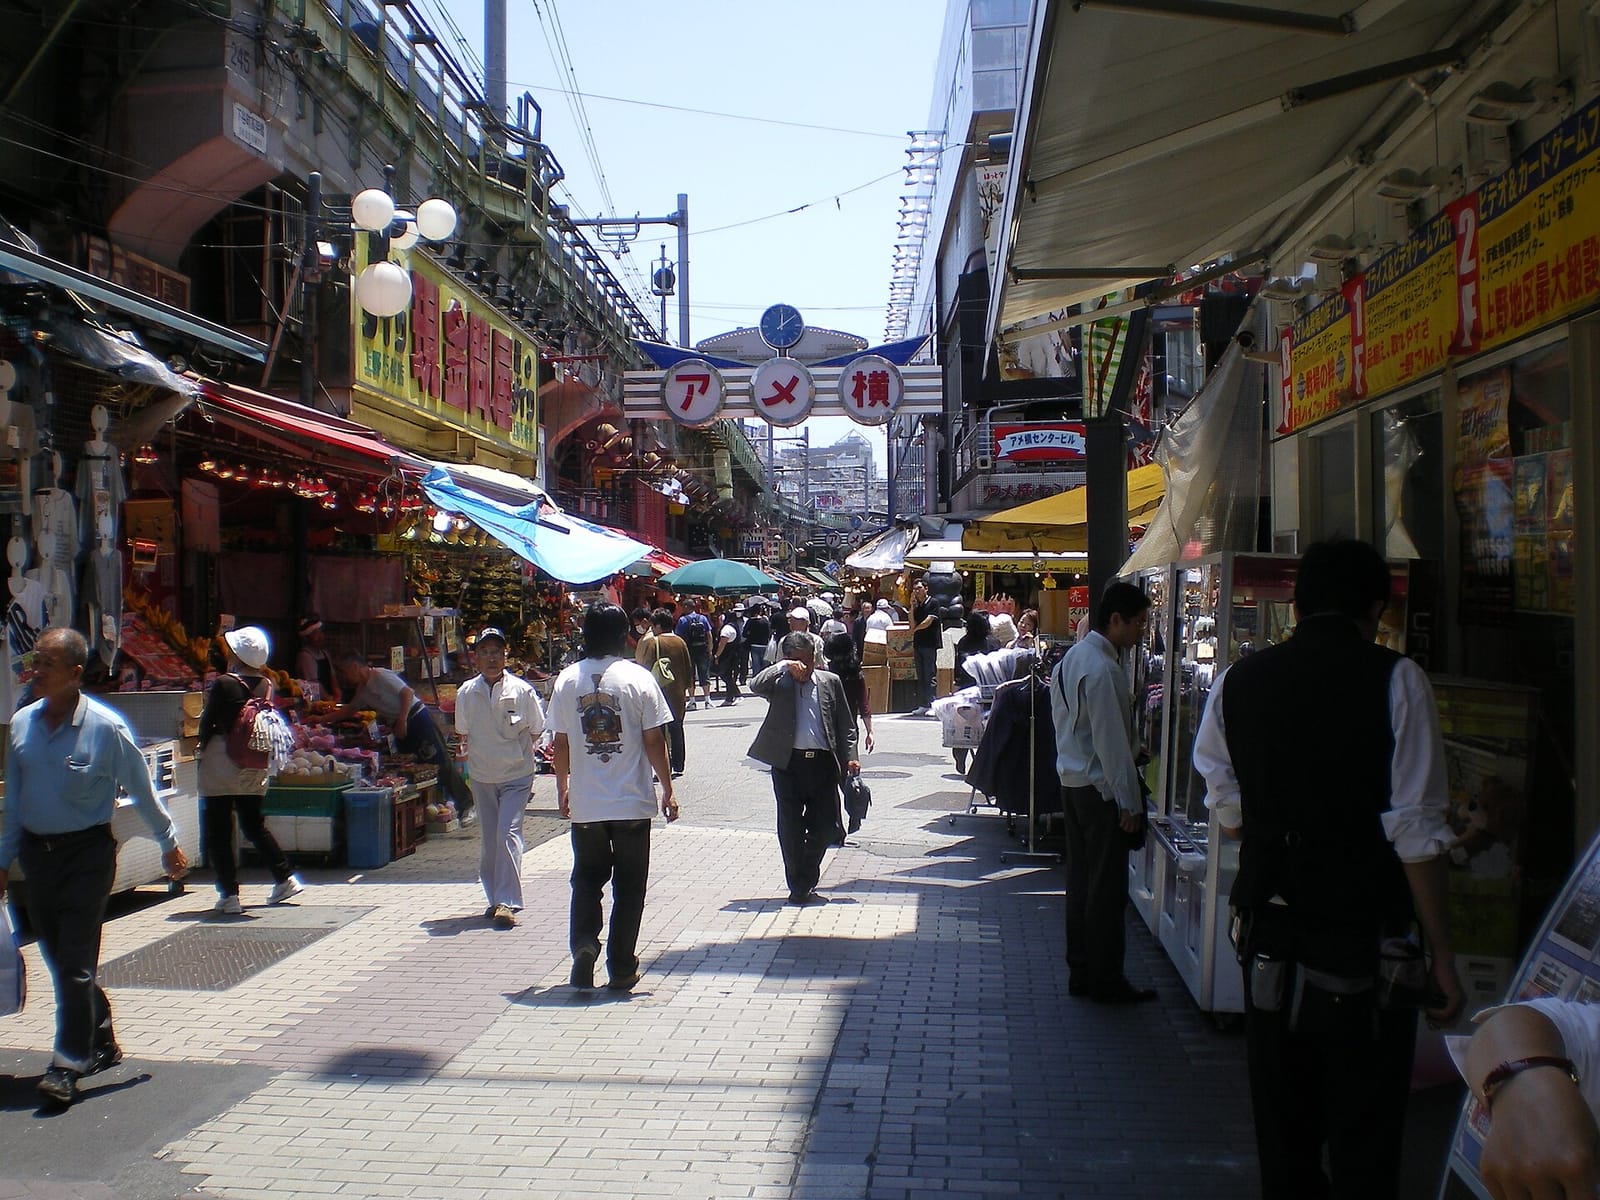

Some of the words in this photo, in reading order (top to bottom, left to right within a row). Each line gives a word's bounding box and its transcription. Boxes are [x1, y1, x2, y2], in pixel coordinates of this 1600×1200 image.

[231, 42, 250, 73] 245
[1458, 207, 1477, 347] 2F
[675, 371, 890, 411] アメ横
[1010, 432, 1076, 448] アメ横センタービル
